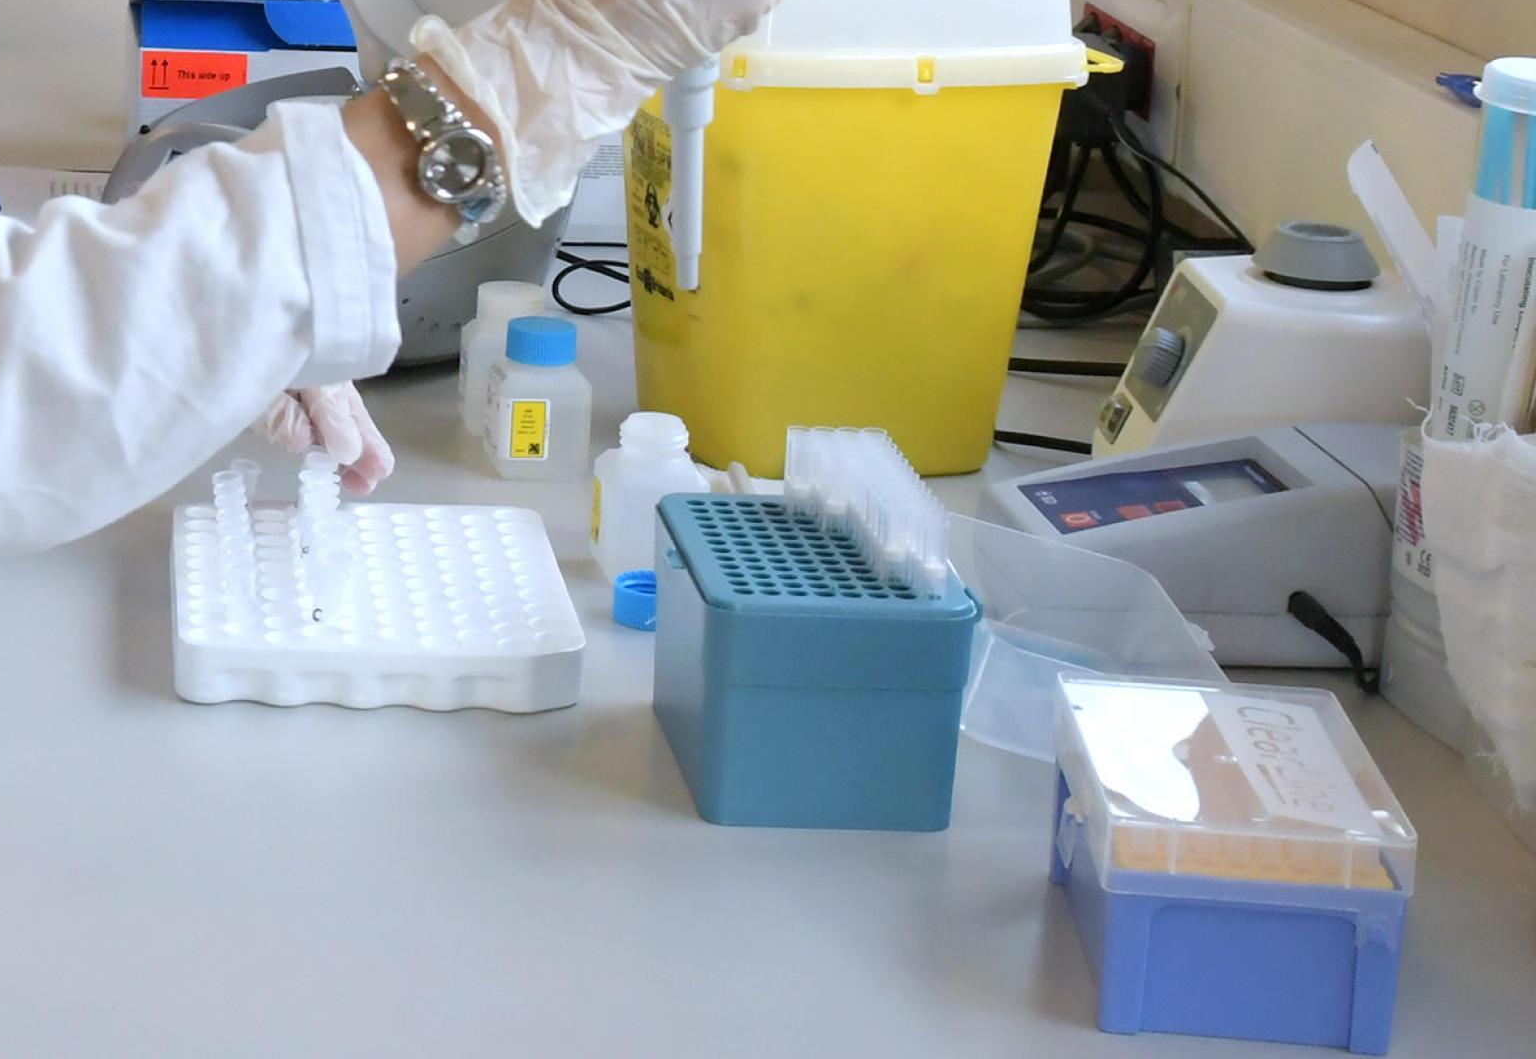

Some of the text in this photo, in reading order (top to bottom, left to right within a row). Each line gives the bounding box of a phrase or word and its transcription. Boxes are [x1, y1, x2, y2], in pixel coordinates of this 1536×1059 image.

[177, 69, 231, 82] This side up
